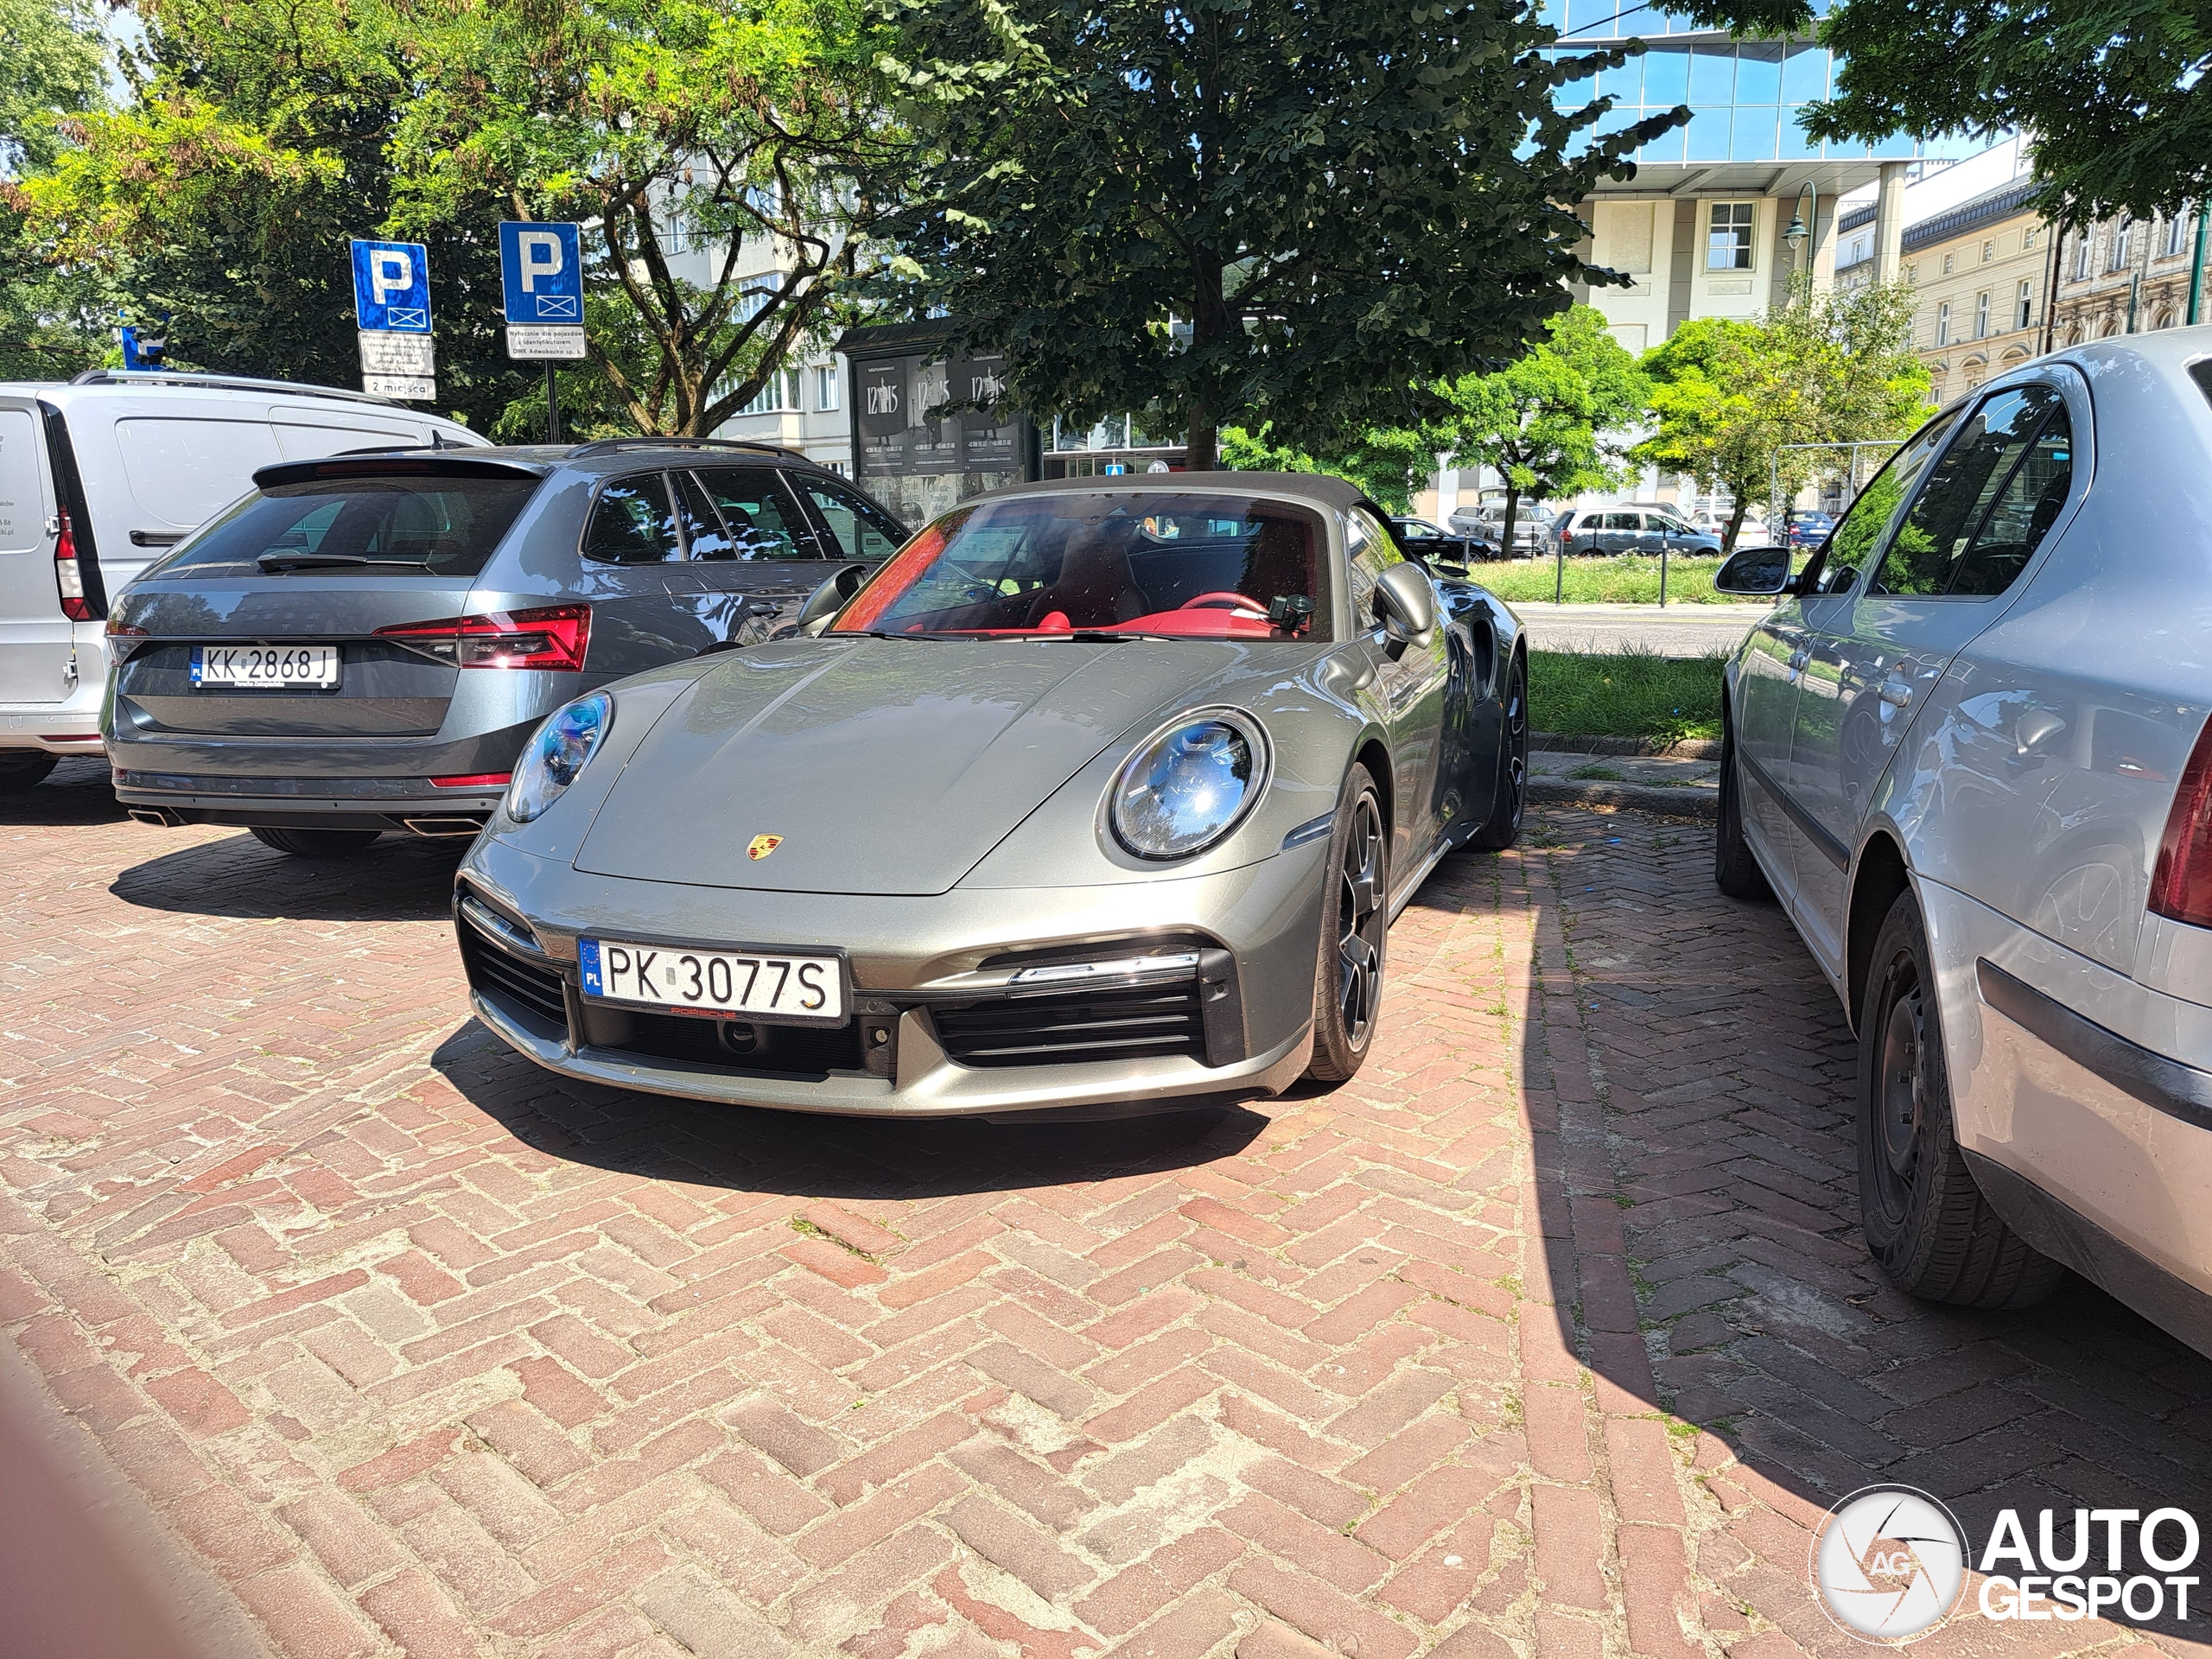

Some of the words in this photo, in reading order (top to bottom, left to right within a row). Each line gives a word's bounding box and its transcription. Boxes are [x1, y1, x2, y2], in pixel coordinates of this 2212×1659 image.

[518, 231, 563, 293] P
[370, 249, 412, 304] P
[372, 382, 379, 391] 2
[193, 668, 201, 677] PL
[207, 650, 238, 679] KK
[248, 650, 327, 679] 2868J
[586, 972, 601, 987] PL
[607, 947, 662, 999] PK
[679, 955, 826, 1010] 3077S
[670, 1007, 736, 1019] PORSCHE
